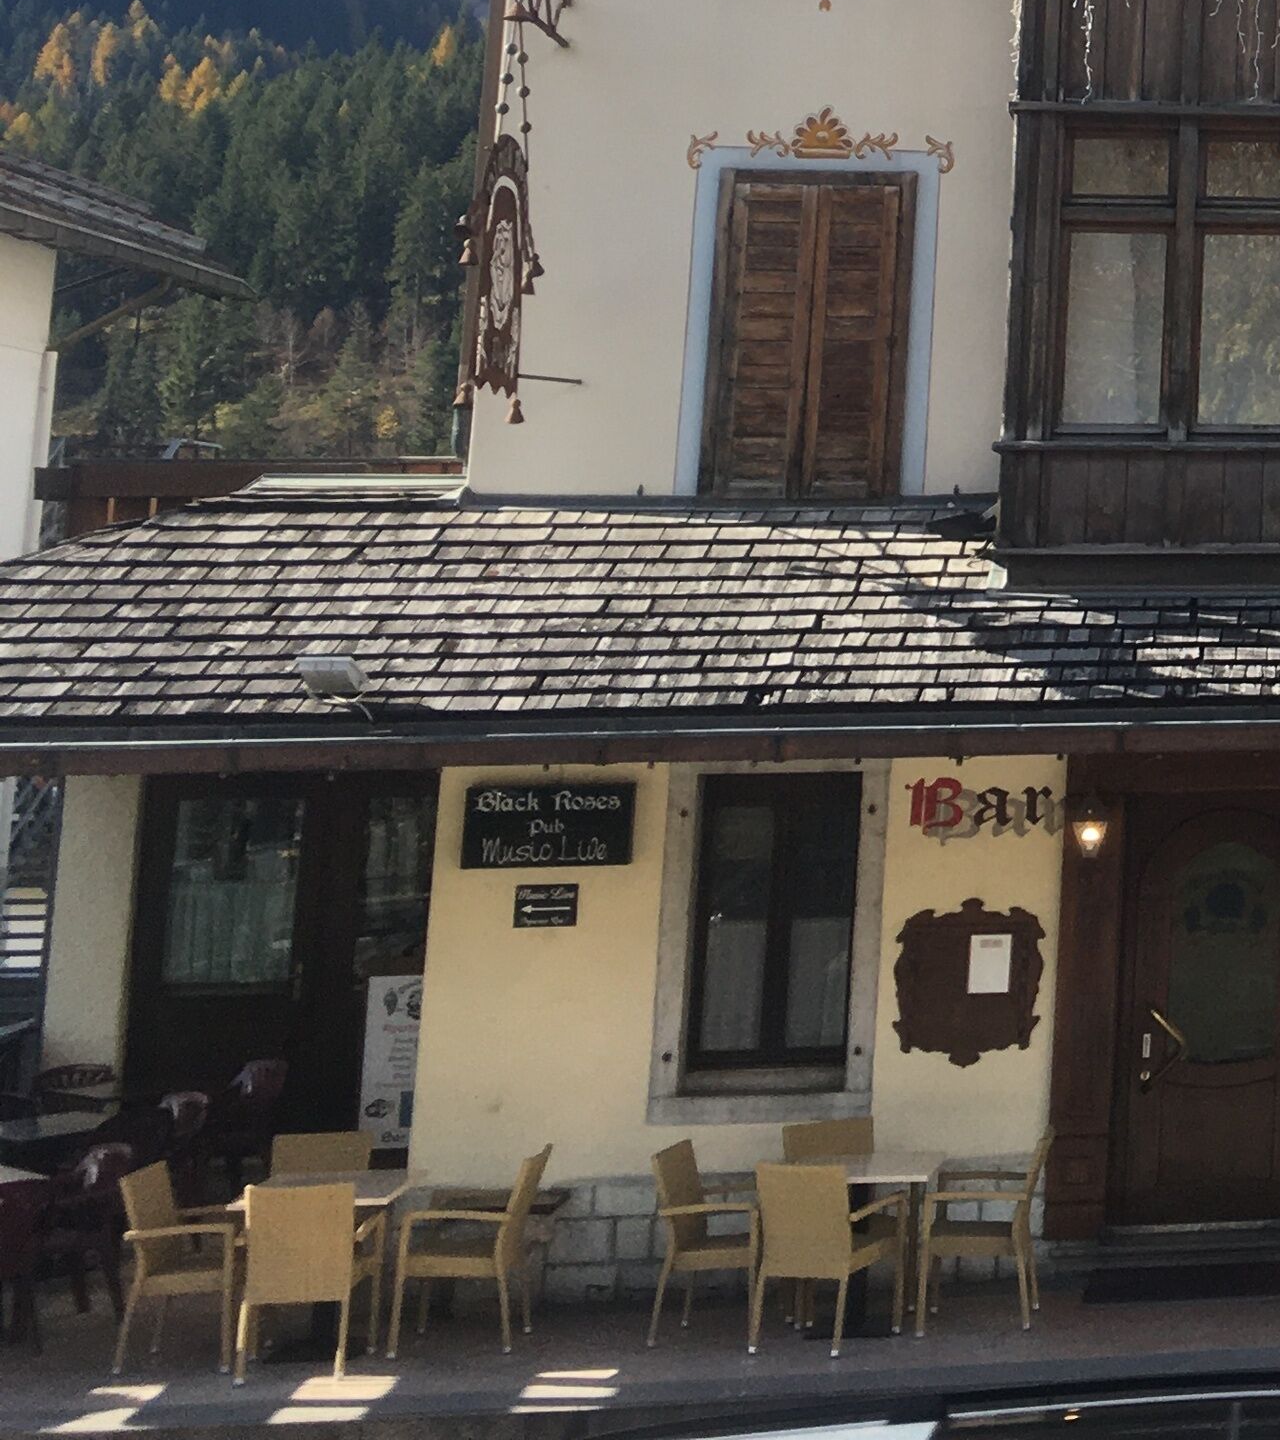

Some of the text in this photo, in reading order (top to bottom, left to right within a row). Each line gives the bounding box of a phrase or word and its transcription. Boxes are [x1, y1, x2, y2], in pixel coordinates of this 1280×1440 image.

[476, 790, 622, 812] Black Roses
[905, 777, 1053, 836] Bar
[528, 818, 565, 837] Pub
